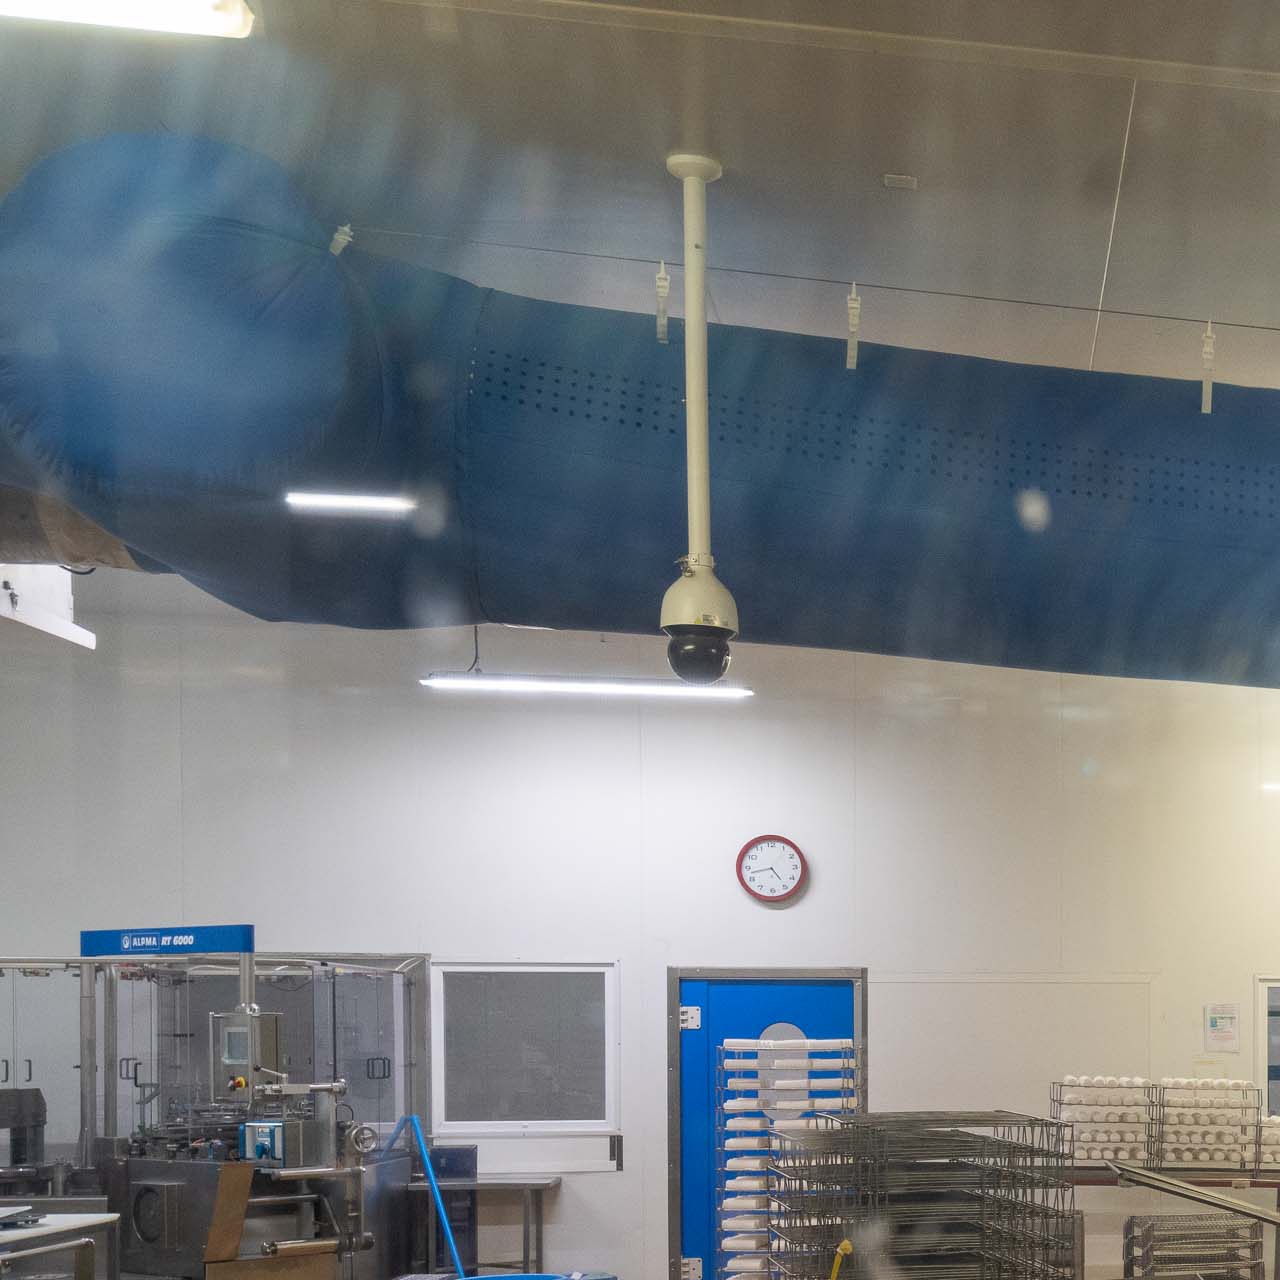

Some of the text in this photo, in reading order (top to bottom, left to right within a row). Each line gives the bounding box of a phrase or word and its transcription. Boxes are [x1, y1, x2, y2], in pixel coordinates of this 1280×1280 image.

[132, 935, 194, 947] ALPMA RT 6000
